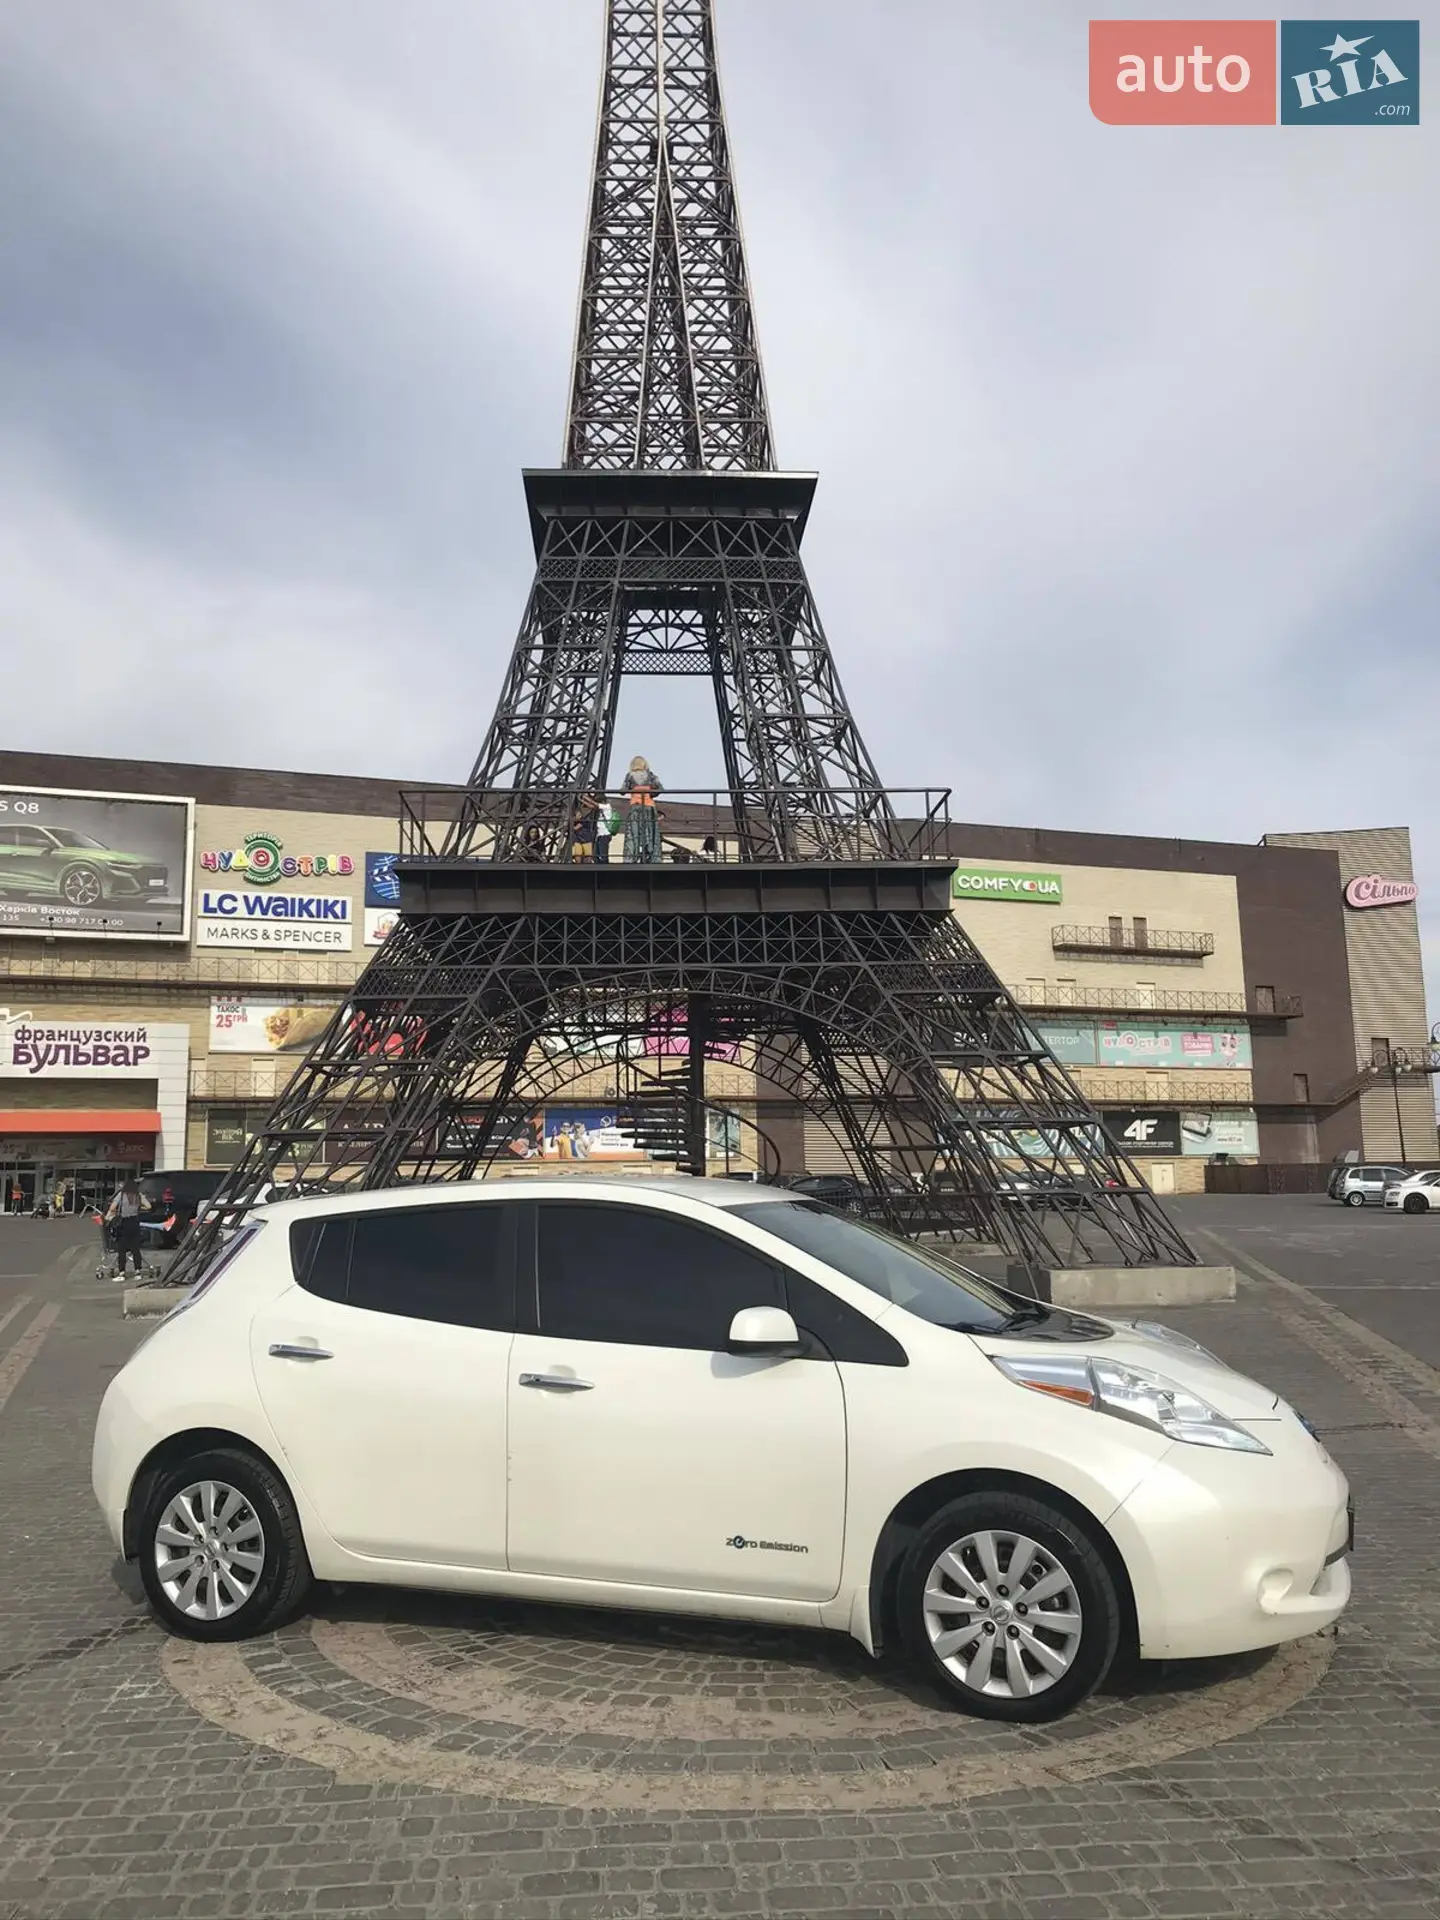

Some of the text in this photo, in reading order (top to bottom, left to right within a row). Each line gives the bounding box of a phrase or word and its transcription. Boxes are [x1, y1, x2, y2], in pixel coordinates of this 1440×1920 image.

[13, 801, 40, 815] Q8
[957, 875, 1060, 894] COMFY UA
[1353, 878, 1416, 901] Сільпо
[203, 892, 238, 915] LC
[207, 927, 342, 944] MARKS & SPENCER
[216, 1014, 233, 1028] 25
[14, 1024, 147, 1046] французский
[1123, 1118, 1158, 1141] 4F
